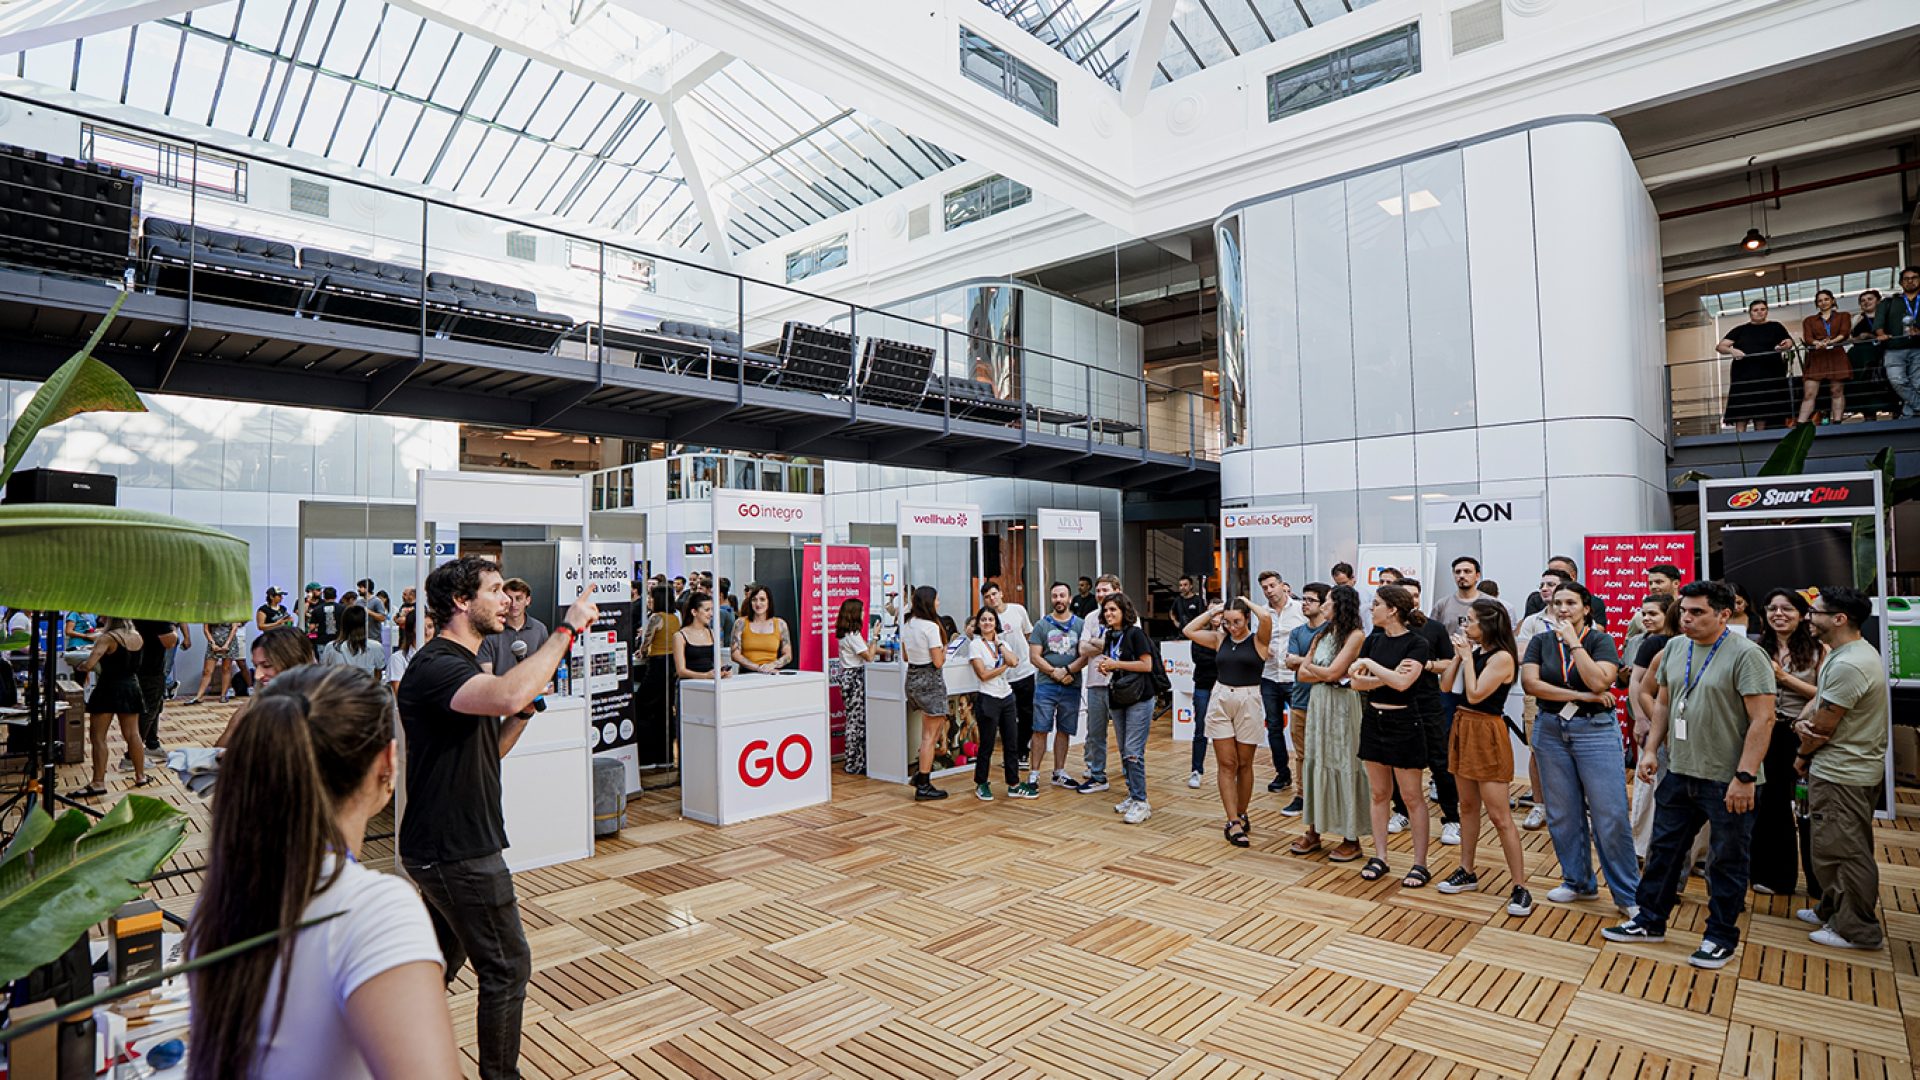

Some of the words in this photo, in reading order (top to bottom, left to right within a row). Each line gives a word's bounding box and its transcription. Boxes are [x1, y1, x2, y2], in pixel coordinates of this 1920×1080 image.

[1762, 486, 1849, 506] SportClub
[913, 513, 956, 525] wellhub
[1453, 502, 1512, 523] AON
[1238, 515, 1270, 526] Galicia
[1271, 514, 1313, 527] Seguros
[565, 567, 578, 579] de
[600, 582, 621, 593] vos!
[738, 733, 813, 788] GO
